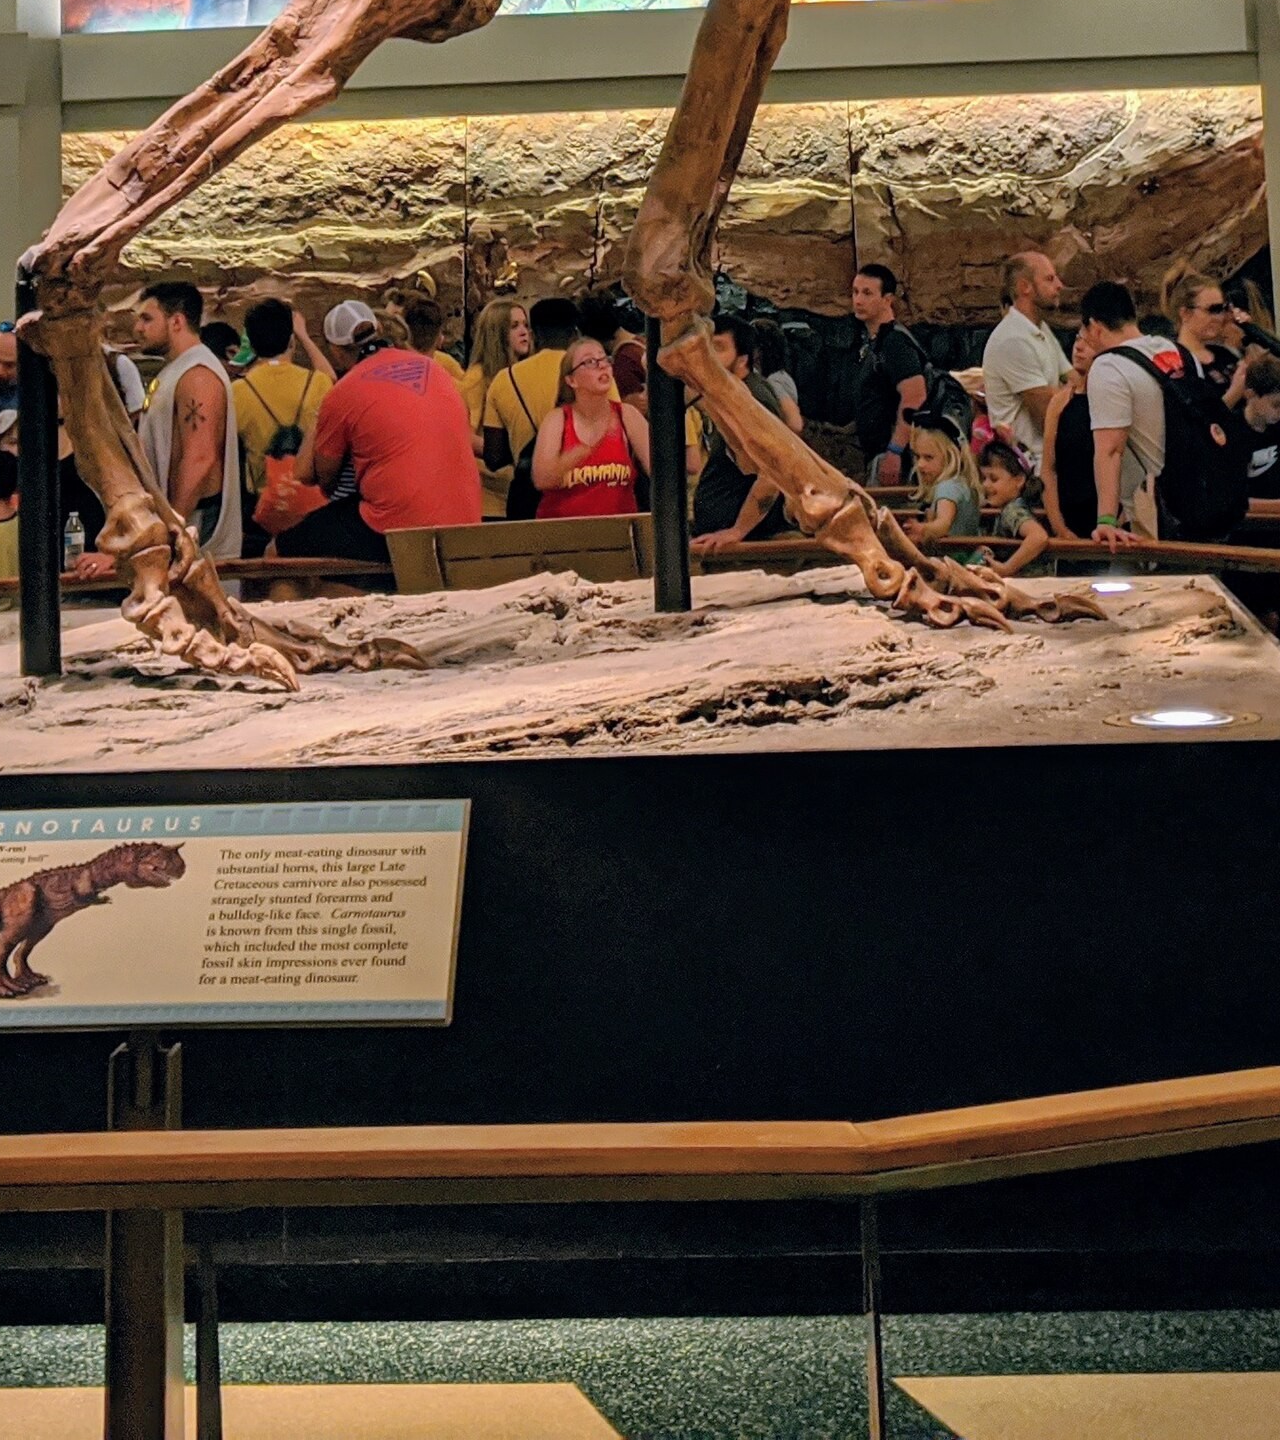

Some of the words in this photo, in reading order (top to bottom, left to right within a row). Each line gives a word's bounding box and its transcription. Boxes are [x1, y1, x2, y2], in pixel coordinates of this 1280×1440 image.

[220, 850, 241, 860] The
[245, 849, 271, 860] only
[275, 848, 342, 858] meat-eating
[346, 847, 397, 856] dinosaur
[401, 846, 426, 855] with
[217, 863, 279, 874] substantial
[283, 863, 318, 873] horns,
[322, 862, 342, 872] this
[347, 861, 376, 874] large
[380, 861, 405, 871] Late
[214, 879, 279, 890] Cretaceous
[282, 878, 338, 888] carnivore
[342, 877, 365, 887] also
[368, 876, 427, 889] possessed
[211, 895, 266, 906] strangely
[269, 894, 312, 904] stunted
[316, 893, 367, 904] forearms
[371, 892, 393, 902] and
[219, 910, 291, 922] bulldog-like
[331, 908, 406, 919] Carnotaurus
[207, 927, 216, 936] is
[220, 926, 260, 936] known
[265, 926, 292, 935] from
[297, 925, 318, 935] this
[322, 925, 357, 937] single
[361, 924, 396, 935] fossil,
[204, 942, 240, 952] which
[244, 941, 295, 952] included
[299, 941, 317, 951] the
[321, 942, 350, 951] most
[353, 939, 408, 953] complete
[202, 958, 234, 968] fossil
[237, 958, 262, 968] skin
[266, 957, 338, 969] impressions
[341, 958, 367, 967] ever
[371, 955, 406, 966] found
[199, 974, 216, 984] for
[220, 976, 226, 984] a
[231, 973, 301, 986] meat-eating
